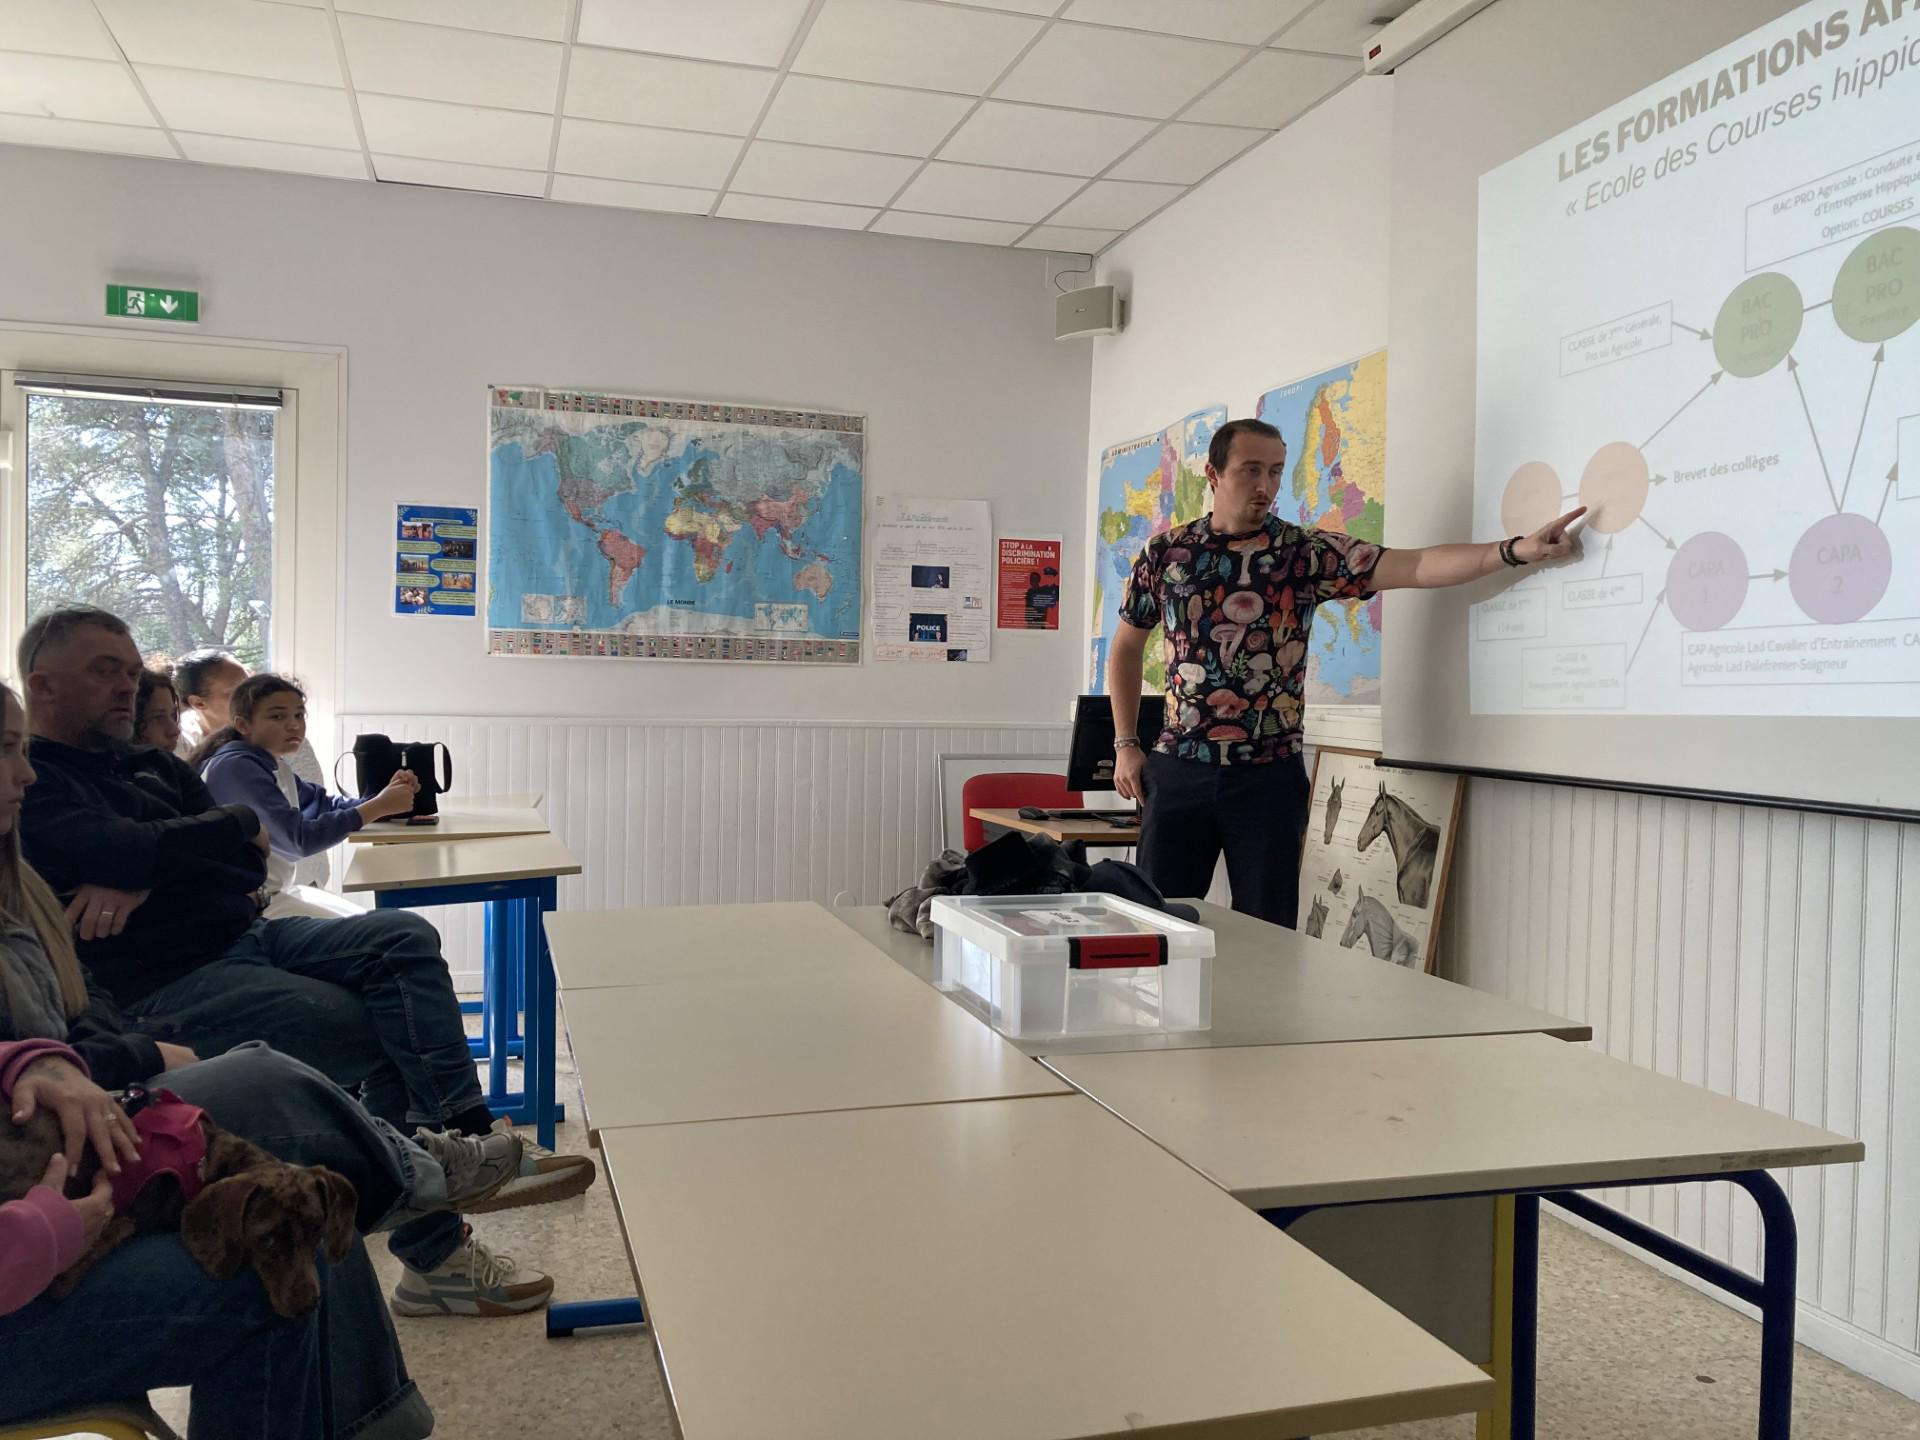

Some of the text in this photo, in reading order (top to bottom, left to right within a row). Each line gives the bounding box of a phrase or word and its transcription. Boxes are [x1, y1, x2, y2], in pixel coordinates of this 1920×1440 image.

[1557, 130, 1610, 183] LES
[1615, 8, 1850, 153] FORMATIONS
[1584, 163, 1646, 212] Ecole
[1653, 139, 1698, 181] des
[1706, 84, 1822, 155] Courses
[1772, 198, 1792, 215] BAC
[1794, 189, 1815, 207] PRO
[1817, 175, 1857, 199] Agricole
[1865, 154, 1913, 180] Conduite
[1862, 196, 1916, 226] COURSES
[1865, 246, 1904, 273] BAC
[1741, 290, 1773, 314] BAC
[1865, 278, 1904, 304] PRO
[1741, 319, 1773, 342] PRO
[1673, 453, 1780, 484] Brevet des collèges
[1001, 541, 1019, 549] STOP
[1001, 549, 1056, 559] DISCRIMINATION
[1816, 544, 1863, 565] CAPA
[1688, 559, 1725, 579] CAPA
[1831, 575, 1845, 595] 2
[916, 624, 941, 632] POLICE
[1687, 642, 1705, 656] CAP
[1708, 641, 1745, 658] Agricole
[1747, 640, 1766, 653] Lad
[1767, 639, 1807, 653] Cavalier
[1687, 661, 1723, 678] Agricole
[1726, 659, 1743, 672] Lad
